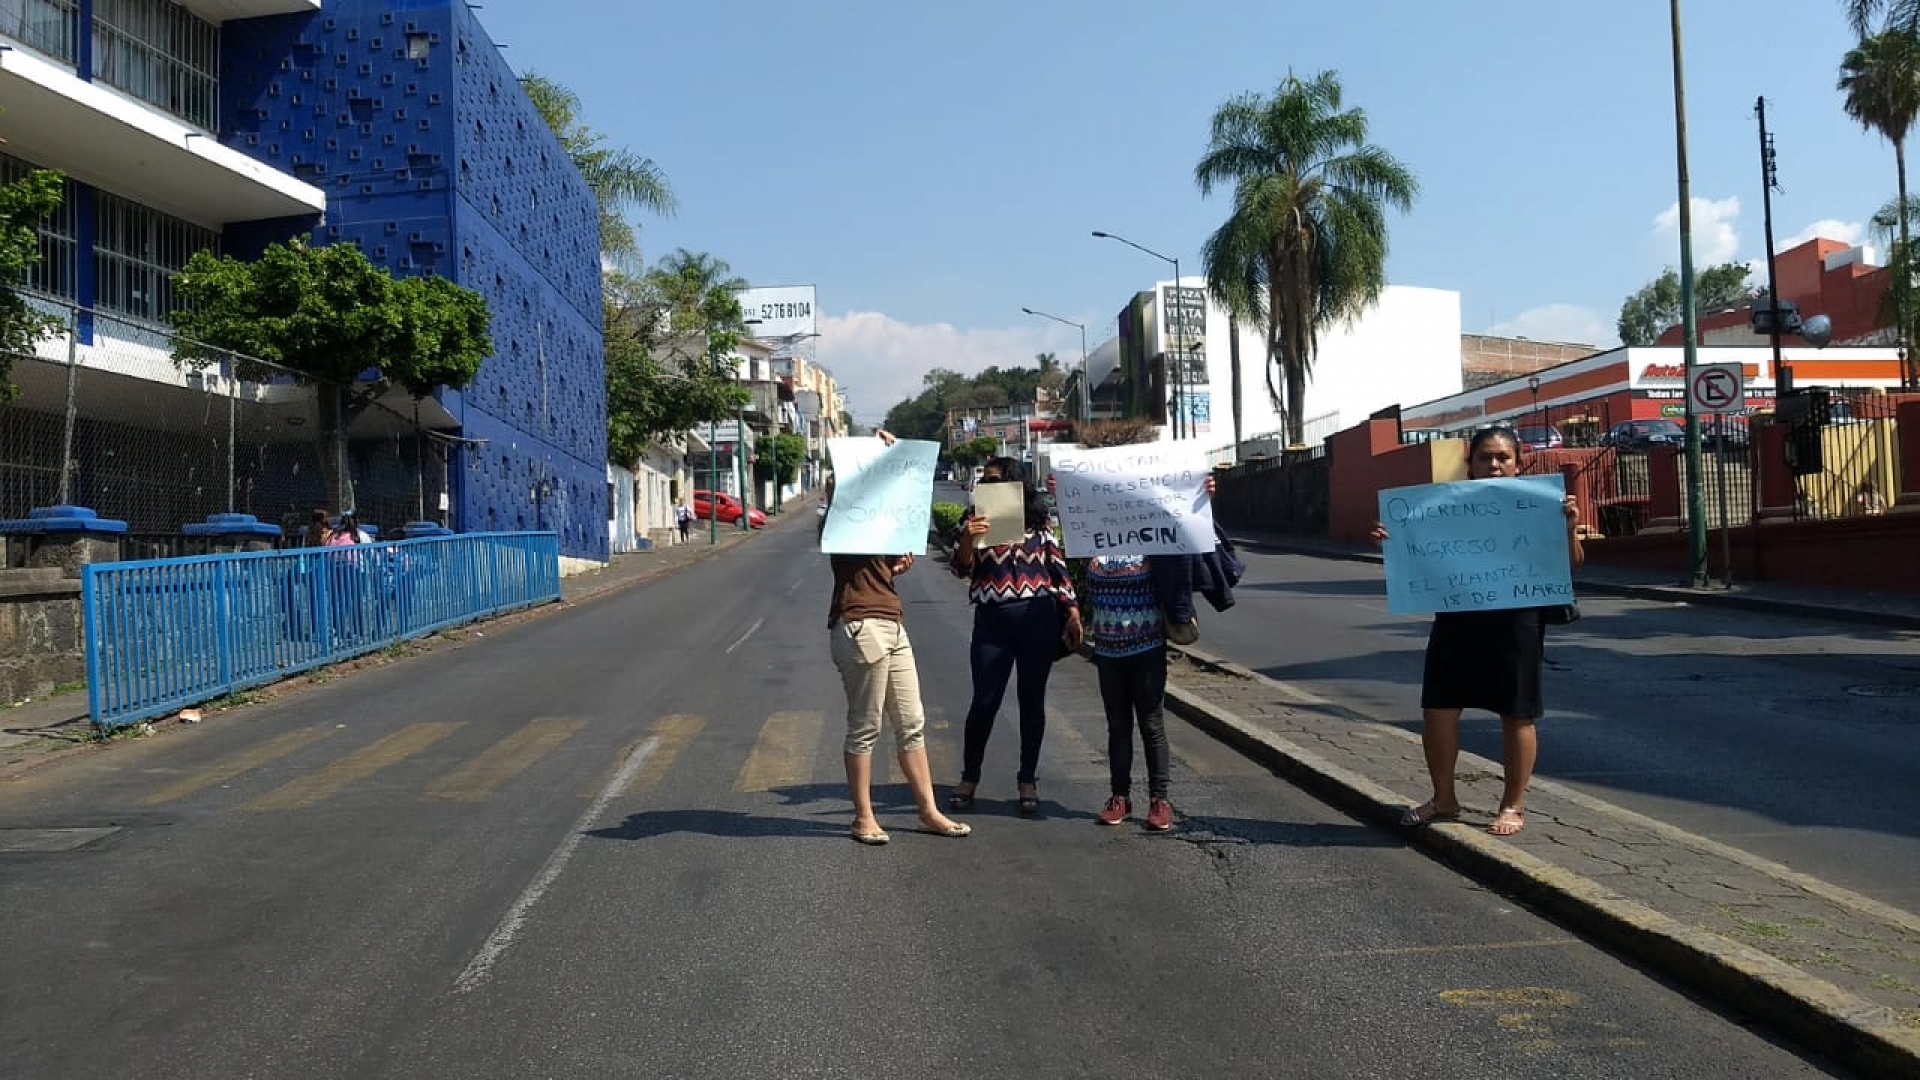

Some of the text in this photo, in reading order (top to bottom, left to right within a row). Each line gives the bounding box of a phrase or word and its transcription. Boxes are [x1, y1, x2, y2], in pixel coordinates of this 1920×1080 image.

[762, 302, 810, 318] 52768104
[1064, 470, 1192, 498] LA PRESENCIA
[1068, 494, 1188, 514] DEL DIRECTOR
[1515, 499, 1539, 510] EL
[1071, 521, 1089, 531] DE
[1406, 534, 1530, 560] INGRESO A
[1408, 577, 1437, 593] EL
[1471, 590, 1498, 605] DE
